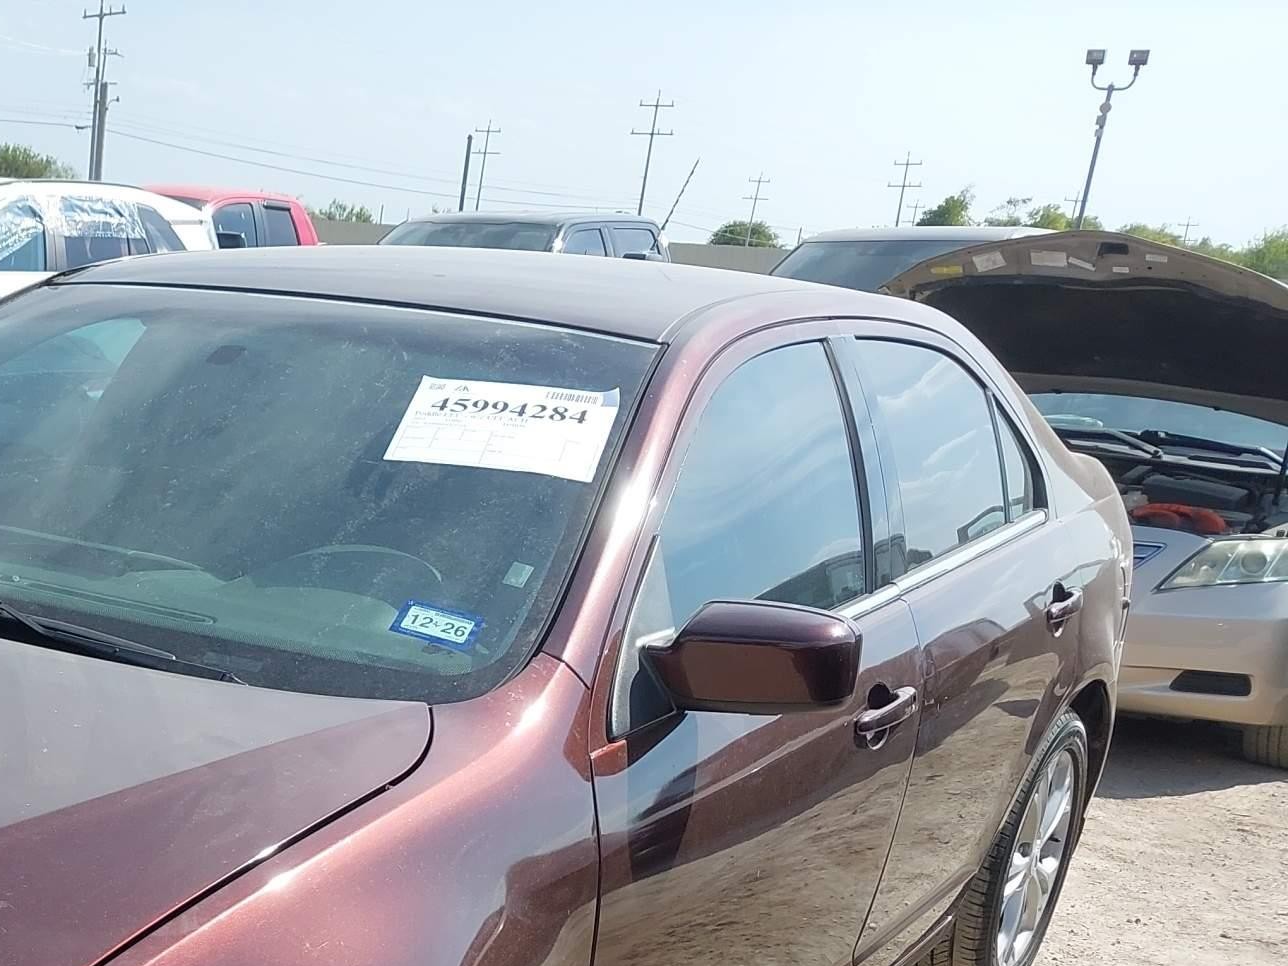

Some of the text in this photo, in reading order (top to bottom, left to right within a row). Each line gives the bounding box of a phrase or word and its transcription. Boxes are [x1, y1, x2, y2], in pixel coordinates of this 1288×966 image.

[431, 397, 589, 424] 45994284
[411, 614, 434, 629] 12
[440, 622, 468, 638] 26
